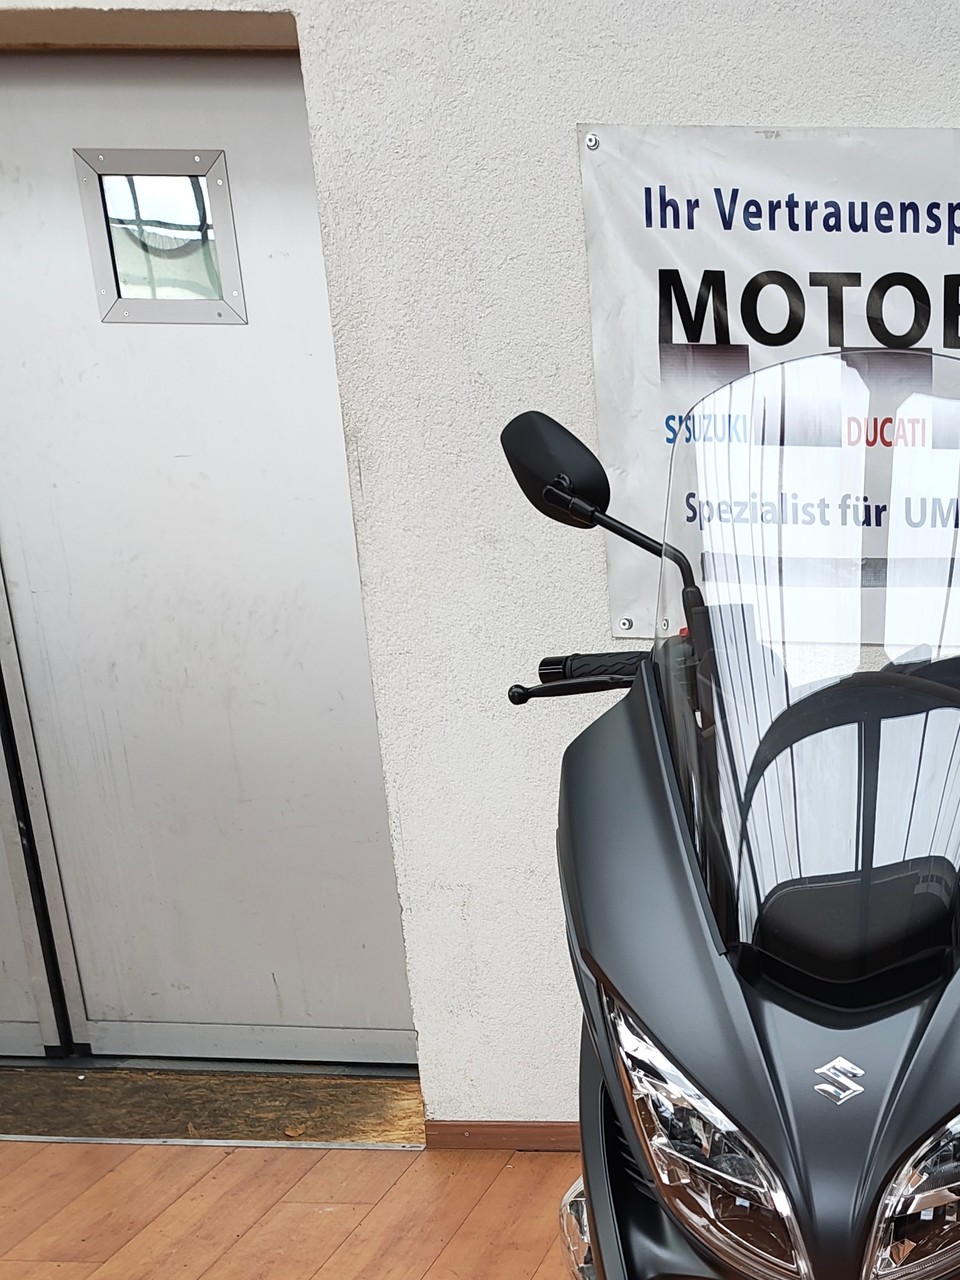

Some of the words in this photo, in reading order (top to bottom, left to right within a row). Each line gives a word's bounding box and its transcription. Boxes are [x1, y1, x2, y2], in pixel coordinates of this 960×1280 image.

[644, 185, 699, 230] Ihr
[847, 416, 926, 447] DUCATI
[685, 492, 830, 531] Spezialist
[839, 493, 888, 528] für
